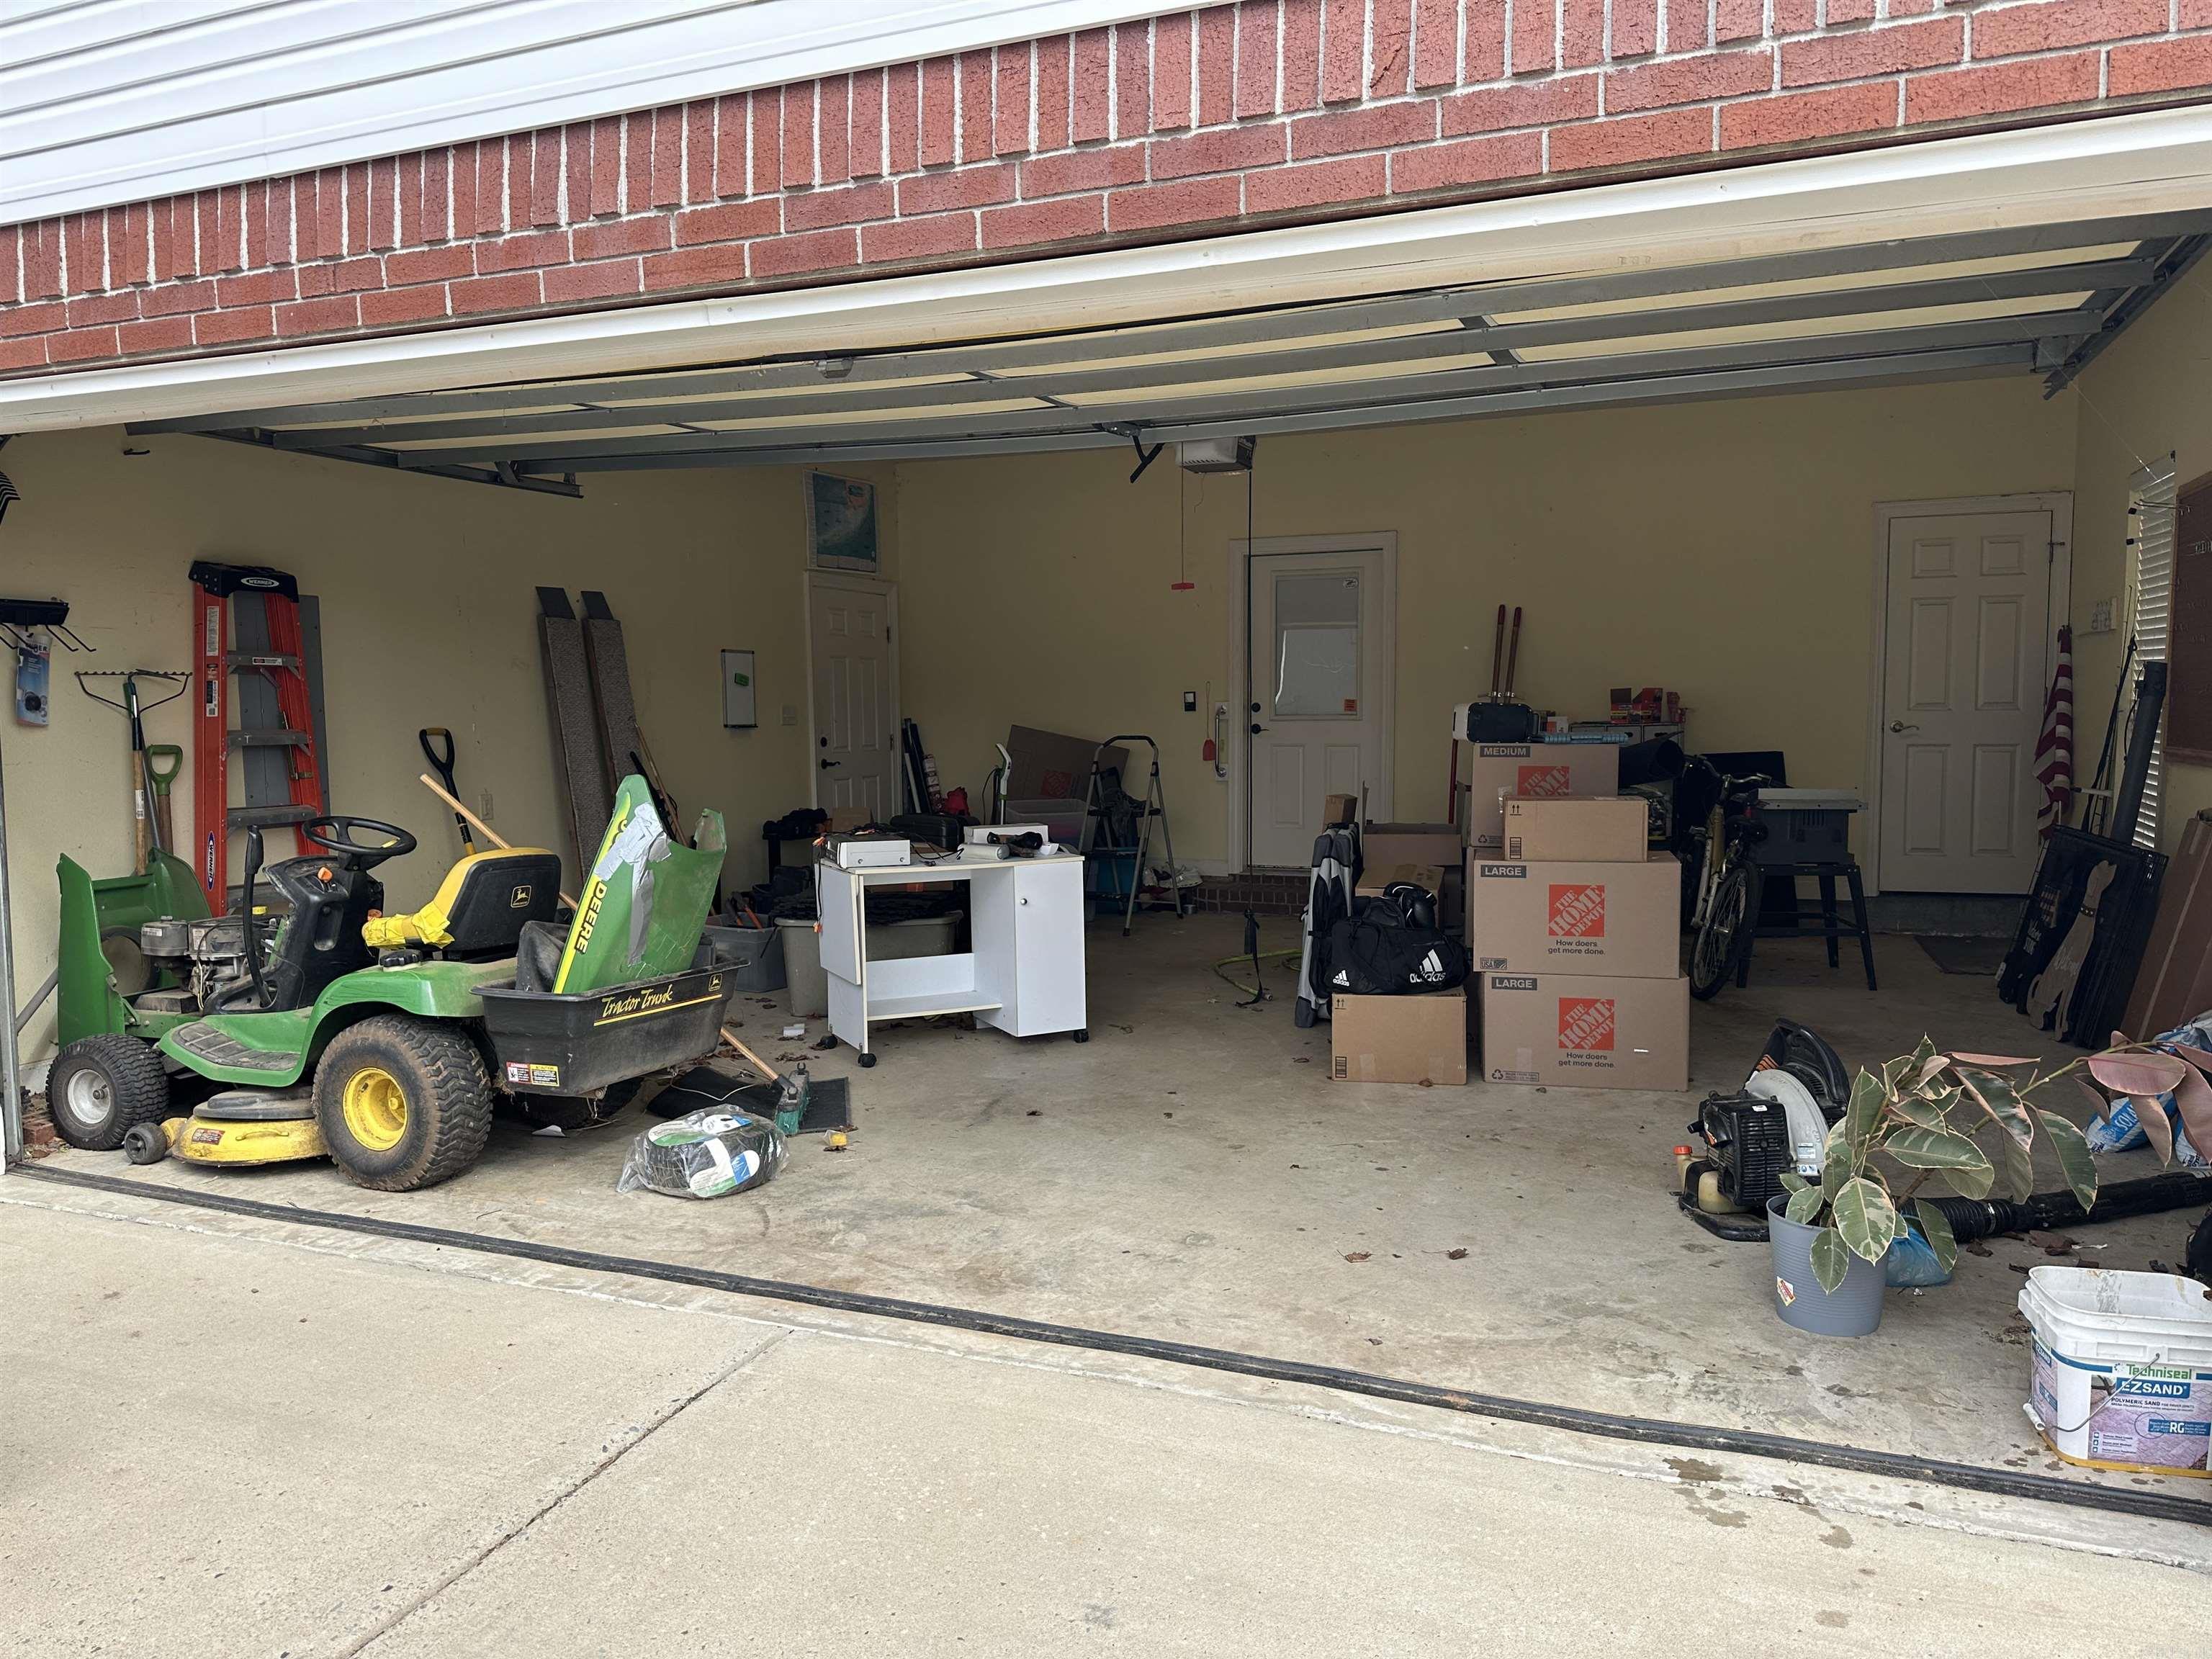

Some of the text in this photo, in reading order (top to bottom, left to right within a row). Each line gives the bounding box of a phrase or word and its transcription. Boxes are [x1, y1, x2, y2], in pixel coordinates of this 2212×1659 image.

[1485, 867, 1521, 876] LARGE
[1549, 885, 1604, 936] HOME
[1555, 890, 1578, 910] THE
[575, 881, 608, 955] DEERE
[1569, 904, 1604, 936] DEPOT
[1496, 979, 1533, 988] LARGE
[602, 984, 673, 1017] Tractor Trunk
[1565, 1003, 1587, 1023] THE
[1559, 999, 1614, 1049] HOME
[1580, 1018, 1614, 1049] DEPOT
[2126, 1364, 2192, 1380] Techniseal
[2170, 1422, 2185, 1433] RG
